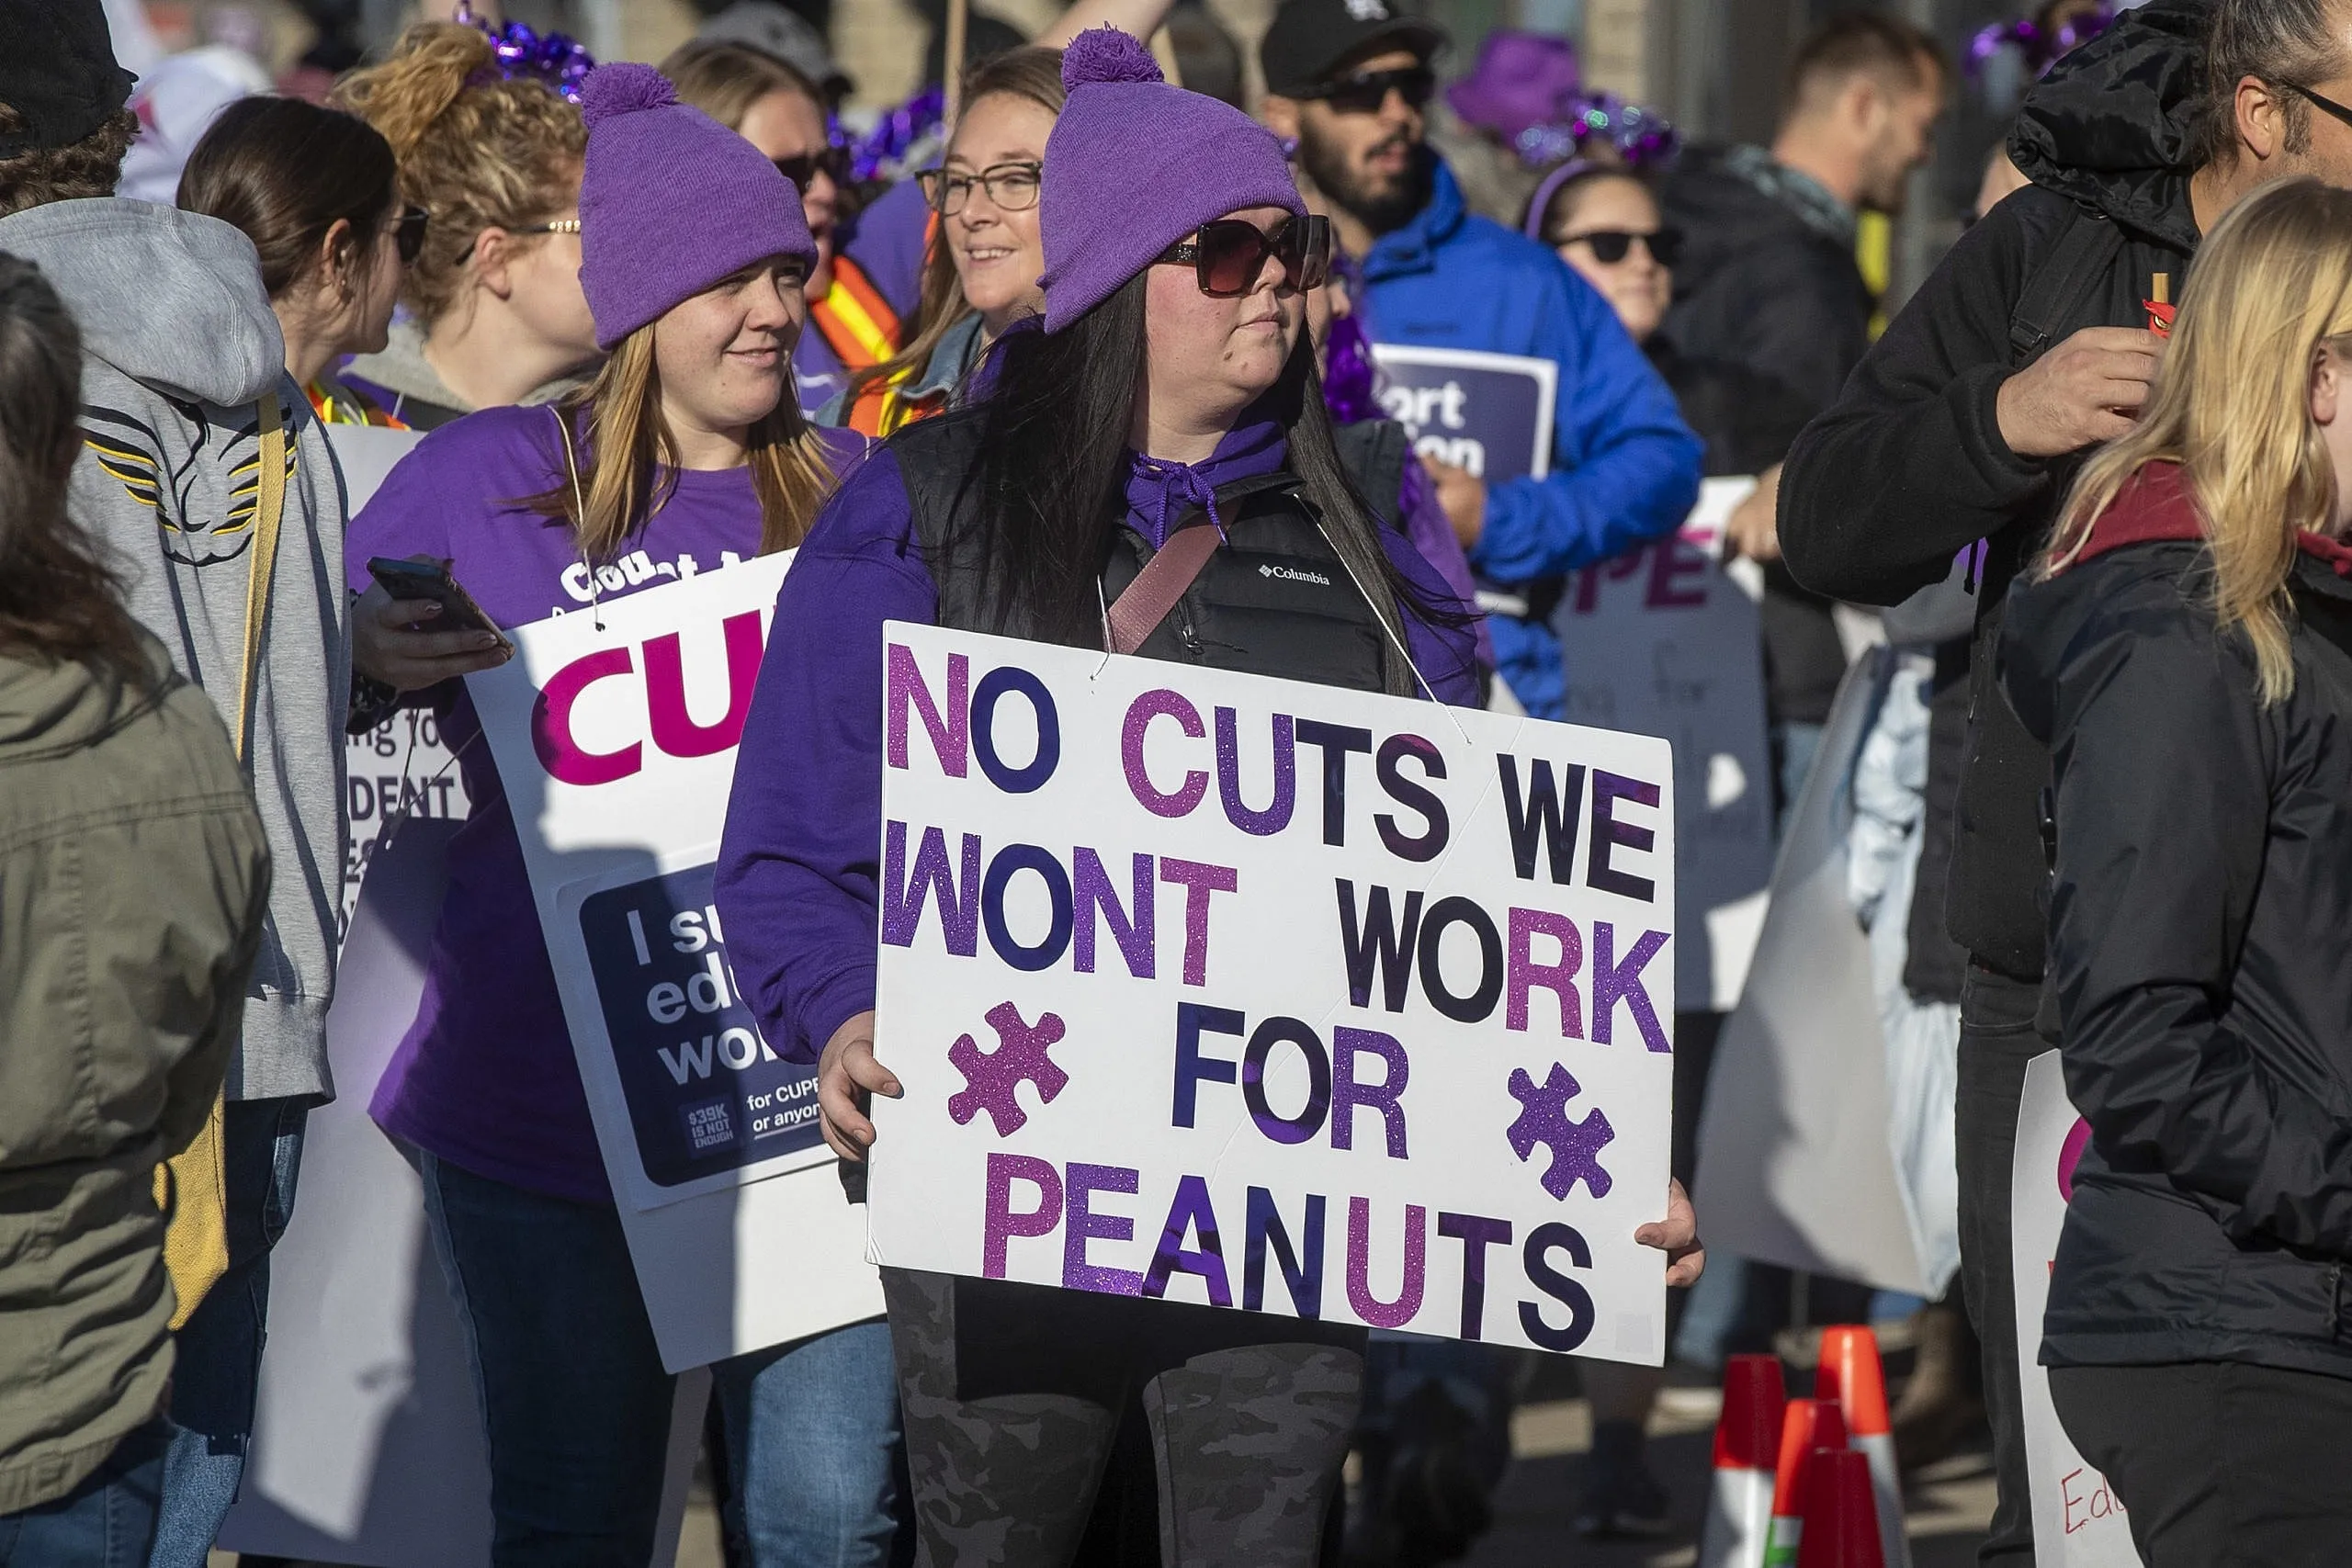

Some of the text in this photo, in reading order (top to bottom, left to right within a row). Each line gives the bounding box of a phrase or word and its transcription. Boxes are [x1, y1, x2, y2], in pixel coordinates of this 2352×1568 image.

[1272, 566, 1330, 586] Columbia
[888, 642, 1060, 794] NO
[1121, 689, 1449, 863] CUTS
[1497, 752, 1662, 903] WE
[627, 909, 651, 965] I
[882, 820, 1673, 1054] WONT WORK
[1171, 1001, 1408, 1160] FOR
[746, 1093, 772, 1111] for
[689, 1103, 728, 1125] $39K
[752, 1116, 770, 1132] or
[707, 1118, 730, 1134] NOT
[694, 1130, 734, 1149] ENOUGH
[983, 1152, 1595, 1352] PEANUTS
